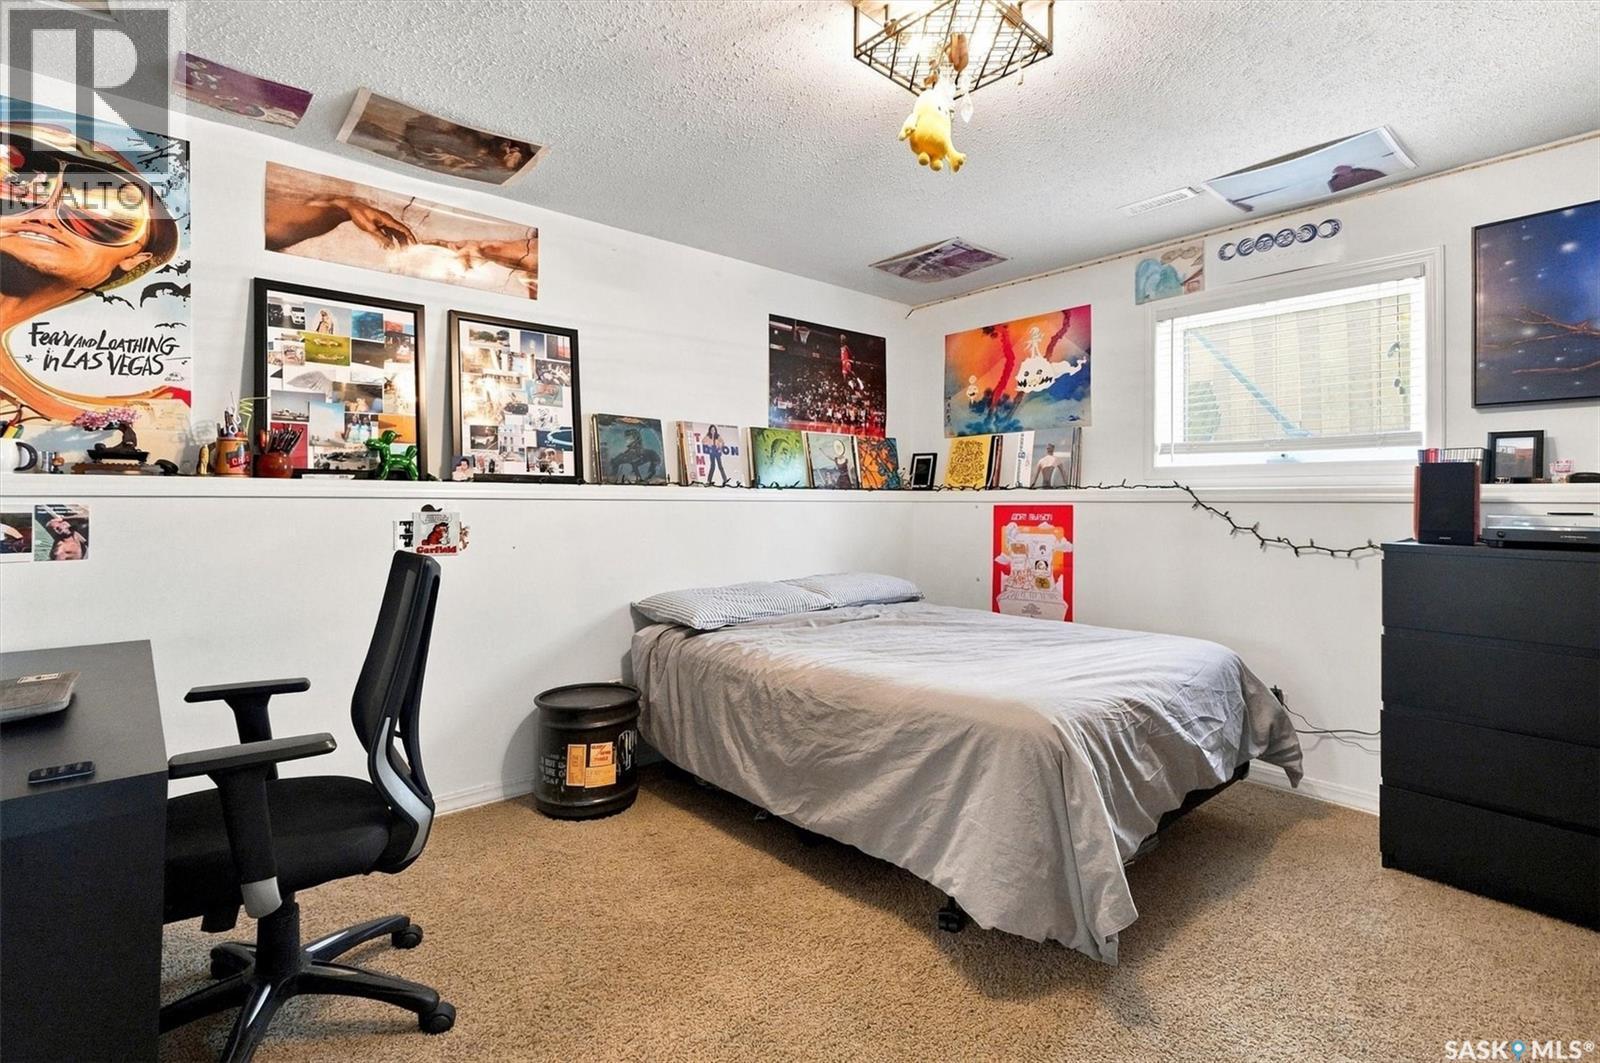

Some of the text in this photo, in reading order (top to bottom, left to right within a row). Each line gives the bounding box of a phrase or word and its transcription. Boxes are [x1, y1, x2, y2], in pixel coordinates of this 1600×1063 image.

[73, 335, 97, 349] AND
[96, 329, 180, 356] LOATHING
[42, 348, 164, 376] in LAS VEGAS
[416, 545, 457, 554] Garfield
